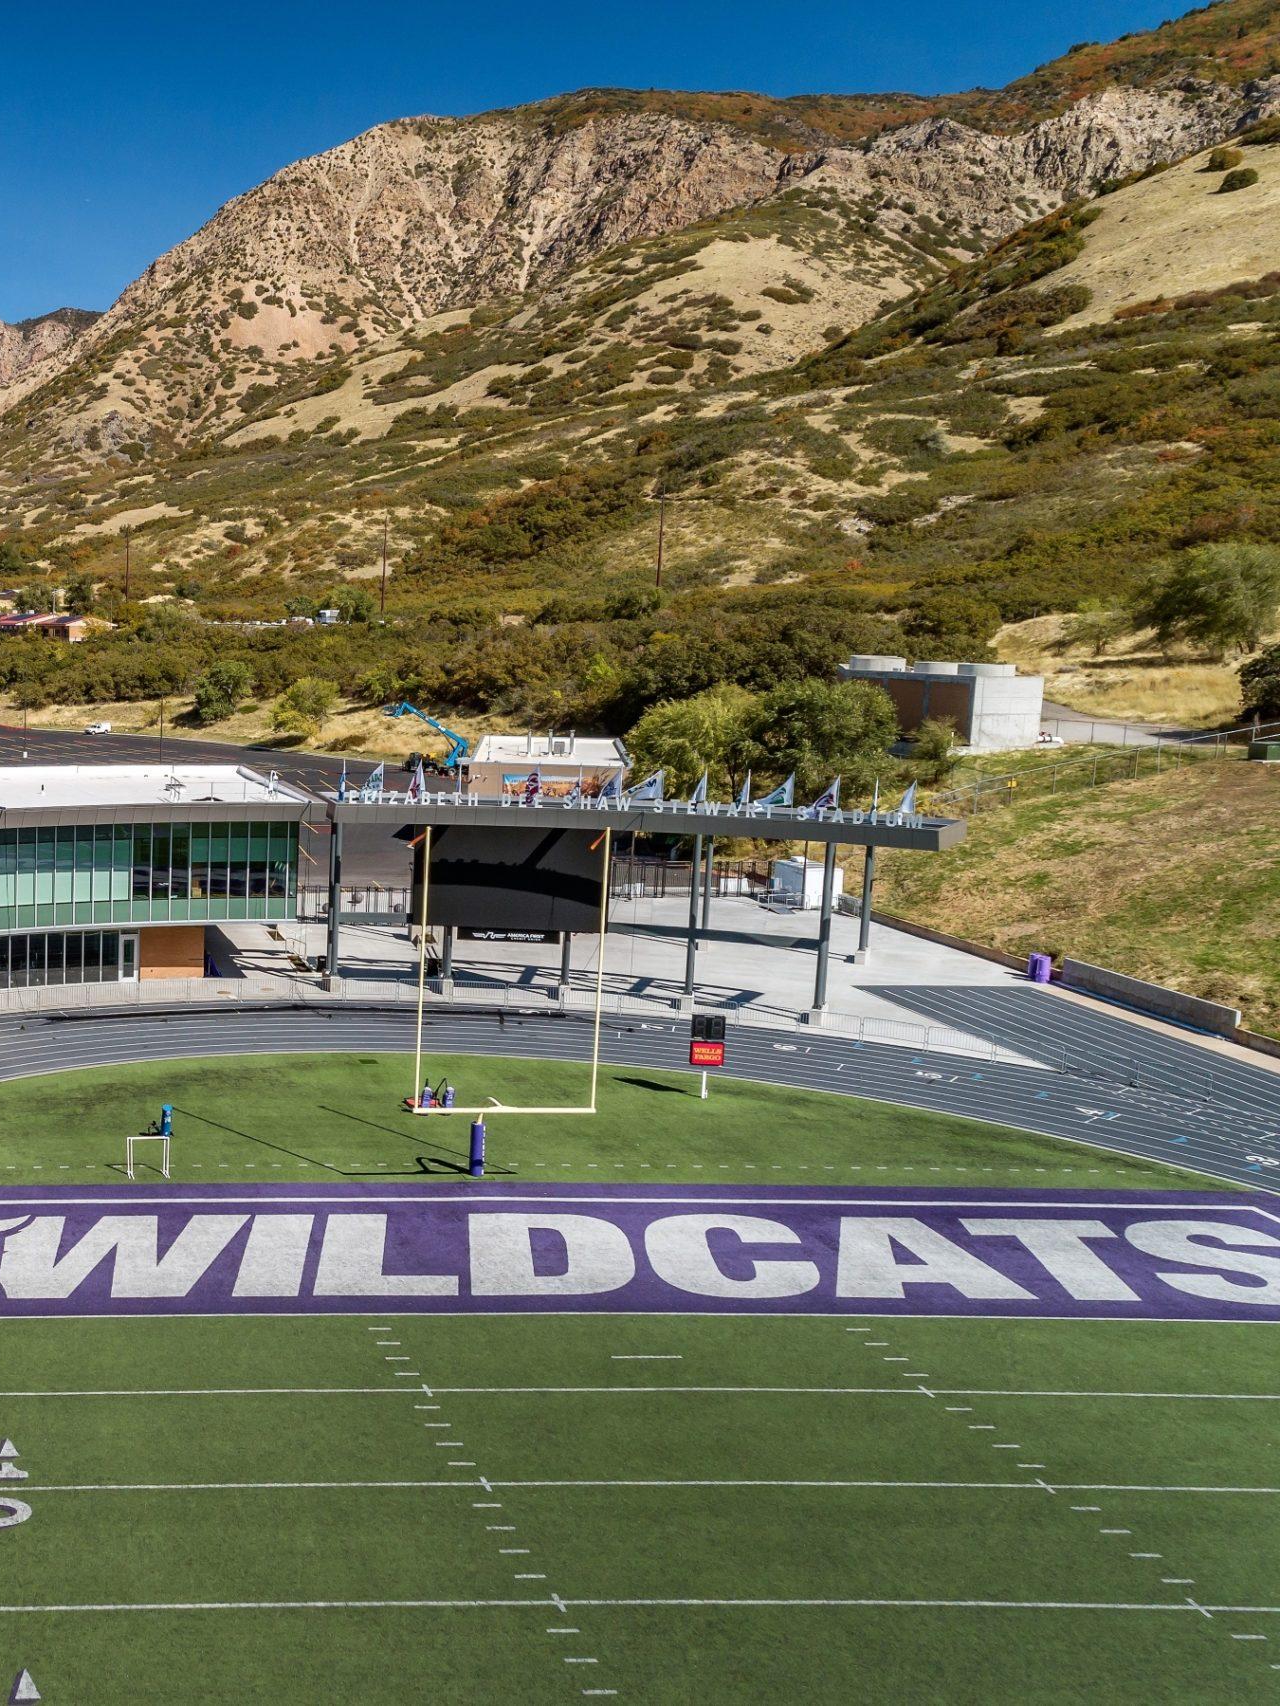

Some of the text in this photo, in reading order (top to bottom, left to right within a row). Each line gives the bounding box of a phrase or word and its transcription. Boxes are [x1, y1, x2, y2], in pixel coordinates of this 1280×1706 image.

[349, 790, 923, 830] ELIZABETH DEE SHAW STEWART STADIUM
[0, 1214, 1280, 1305] WILDCATS
